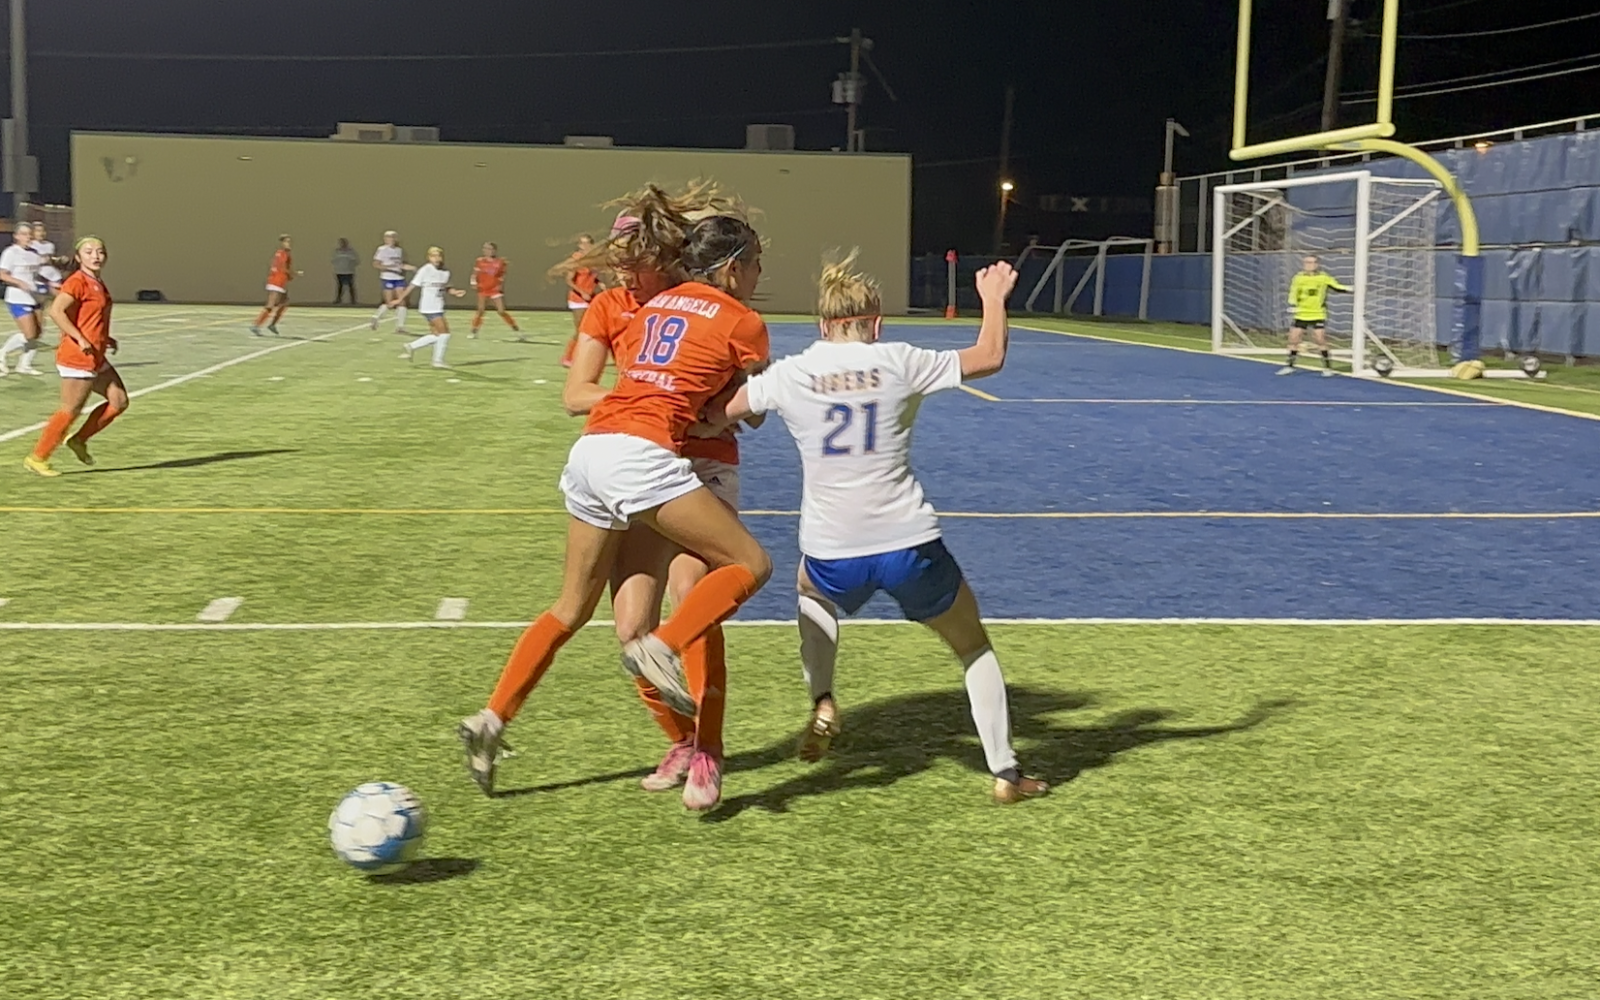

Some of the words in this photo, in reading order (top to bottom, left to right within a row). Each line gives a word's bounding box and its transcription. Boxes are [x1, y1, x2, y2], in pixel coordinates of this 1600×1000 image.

[664, 295, 721, 319] ANGELO
[636, 313, 689, 366] 18
[822, 400, 879, 457] 21
